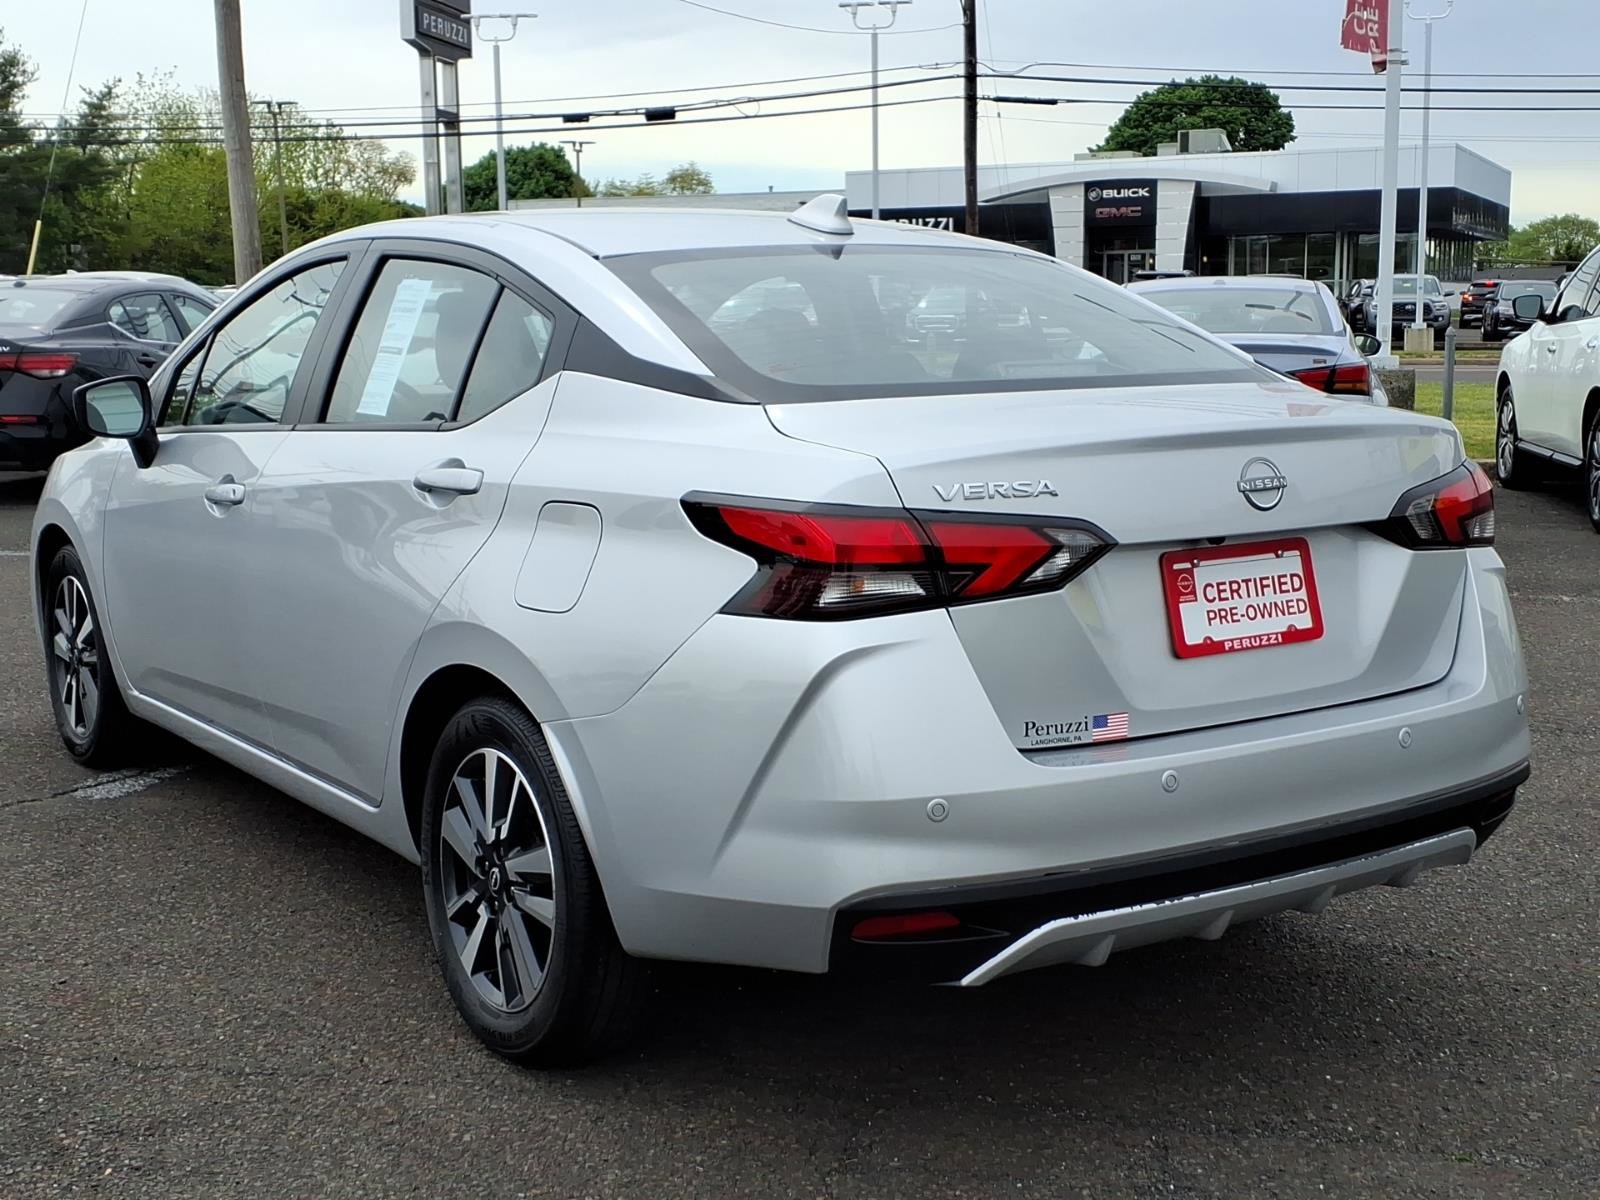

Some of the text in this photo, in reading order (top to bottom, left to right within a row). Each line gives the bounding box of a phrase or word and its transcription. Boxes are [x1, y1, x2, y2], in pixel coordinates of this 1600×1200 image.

[423, 13, 468, 43] PERUZZI
[1354, 0, 1367, 35] CE
[1102, 187, 1150, 198] BUICK
[1095, 206, 1142, 218] GMC
[932, 479, 1059, 502] VERSA
[1240, 478, 1287, 490] NISSAN
[1202, 572, 1304, 604] CERTIFIED
[1206, 598, 1308, 627] PRE-OWNED
[1224, 633, 1283, 651] PERUZZI
[1023, 716, 1089, 737] Peruzzi
[1030, 737, 1073, 746] LANGHORNE,
